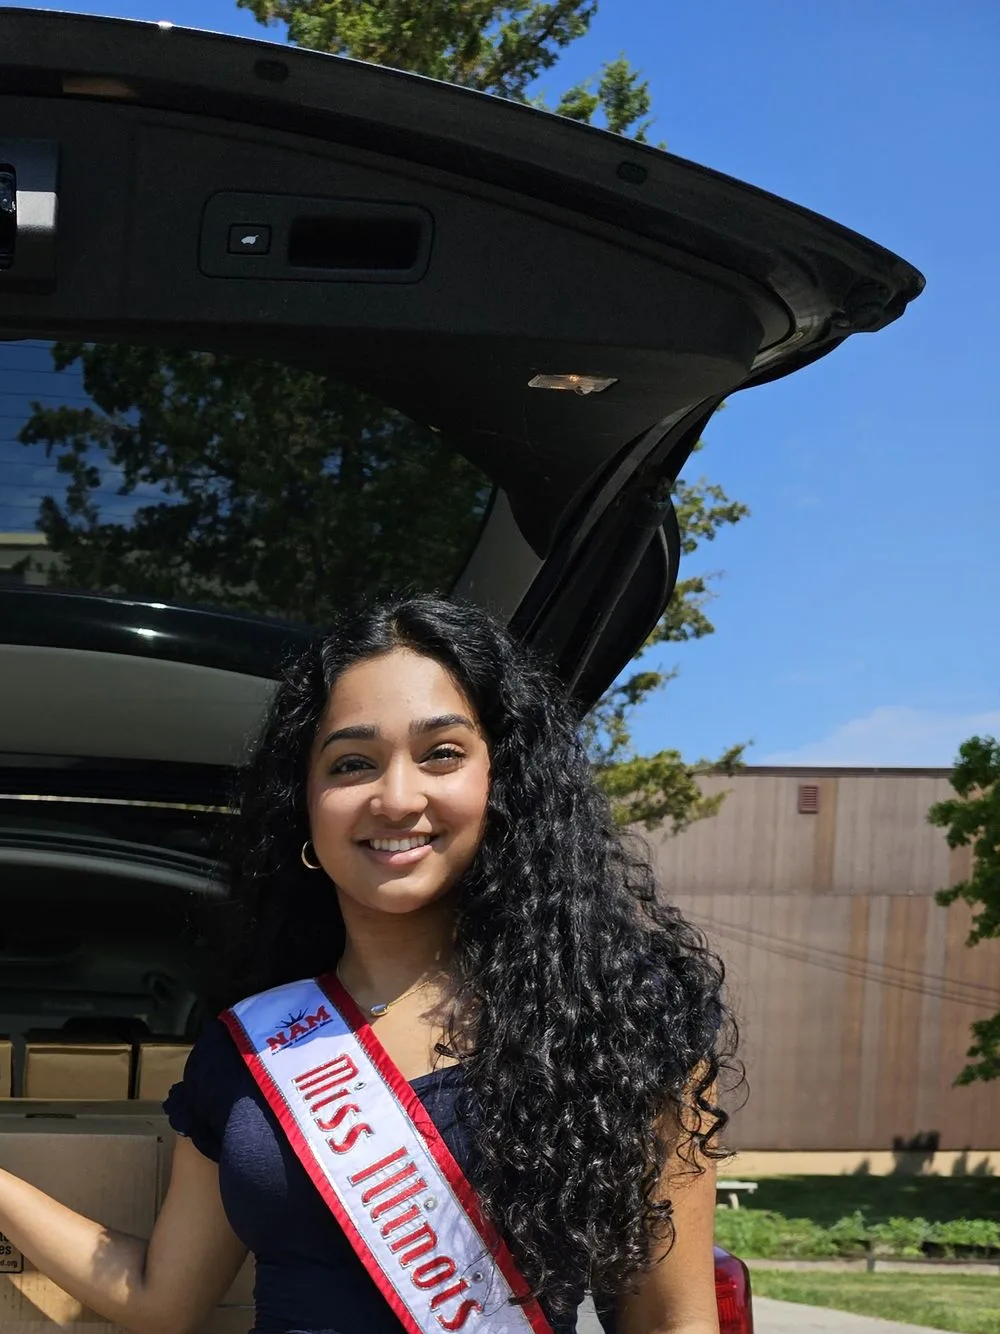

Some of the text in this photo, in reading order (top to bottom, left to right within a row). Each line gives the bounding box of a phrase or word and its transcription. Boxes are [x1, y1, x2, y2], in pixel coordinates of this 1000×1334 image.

[266, 1005, 331, 1051] NAM
[292, 1053, 375, 1155] Miss
[347, 1146, 485, 1332] Illinois
